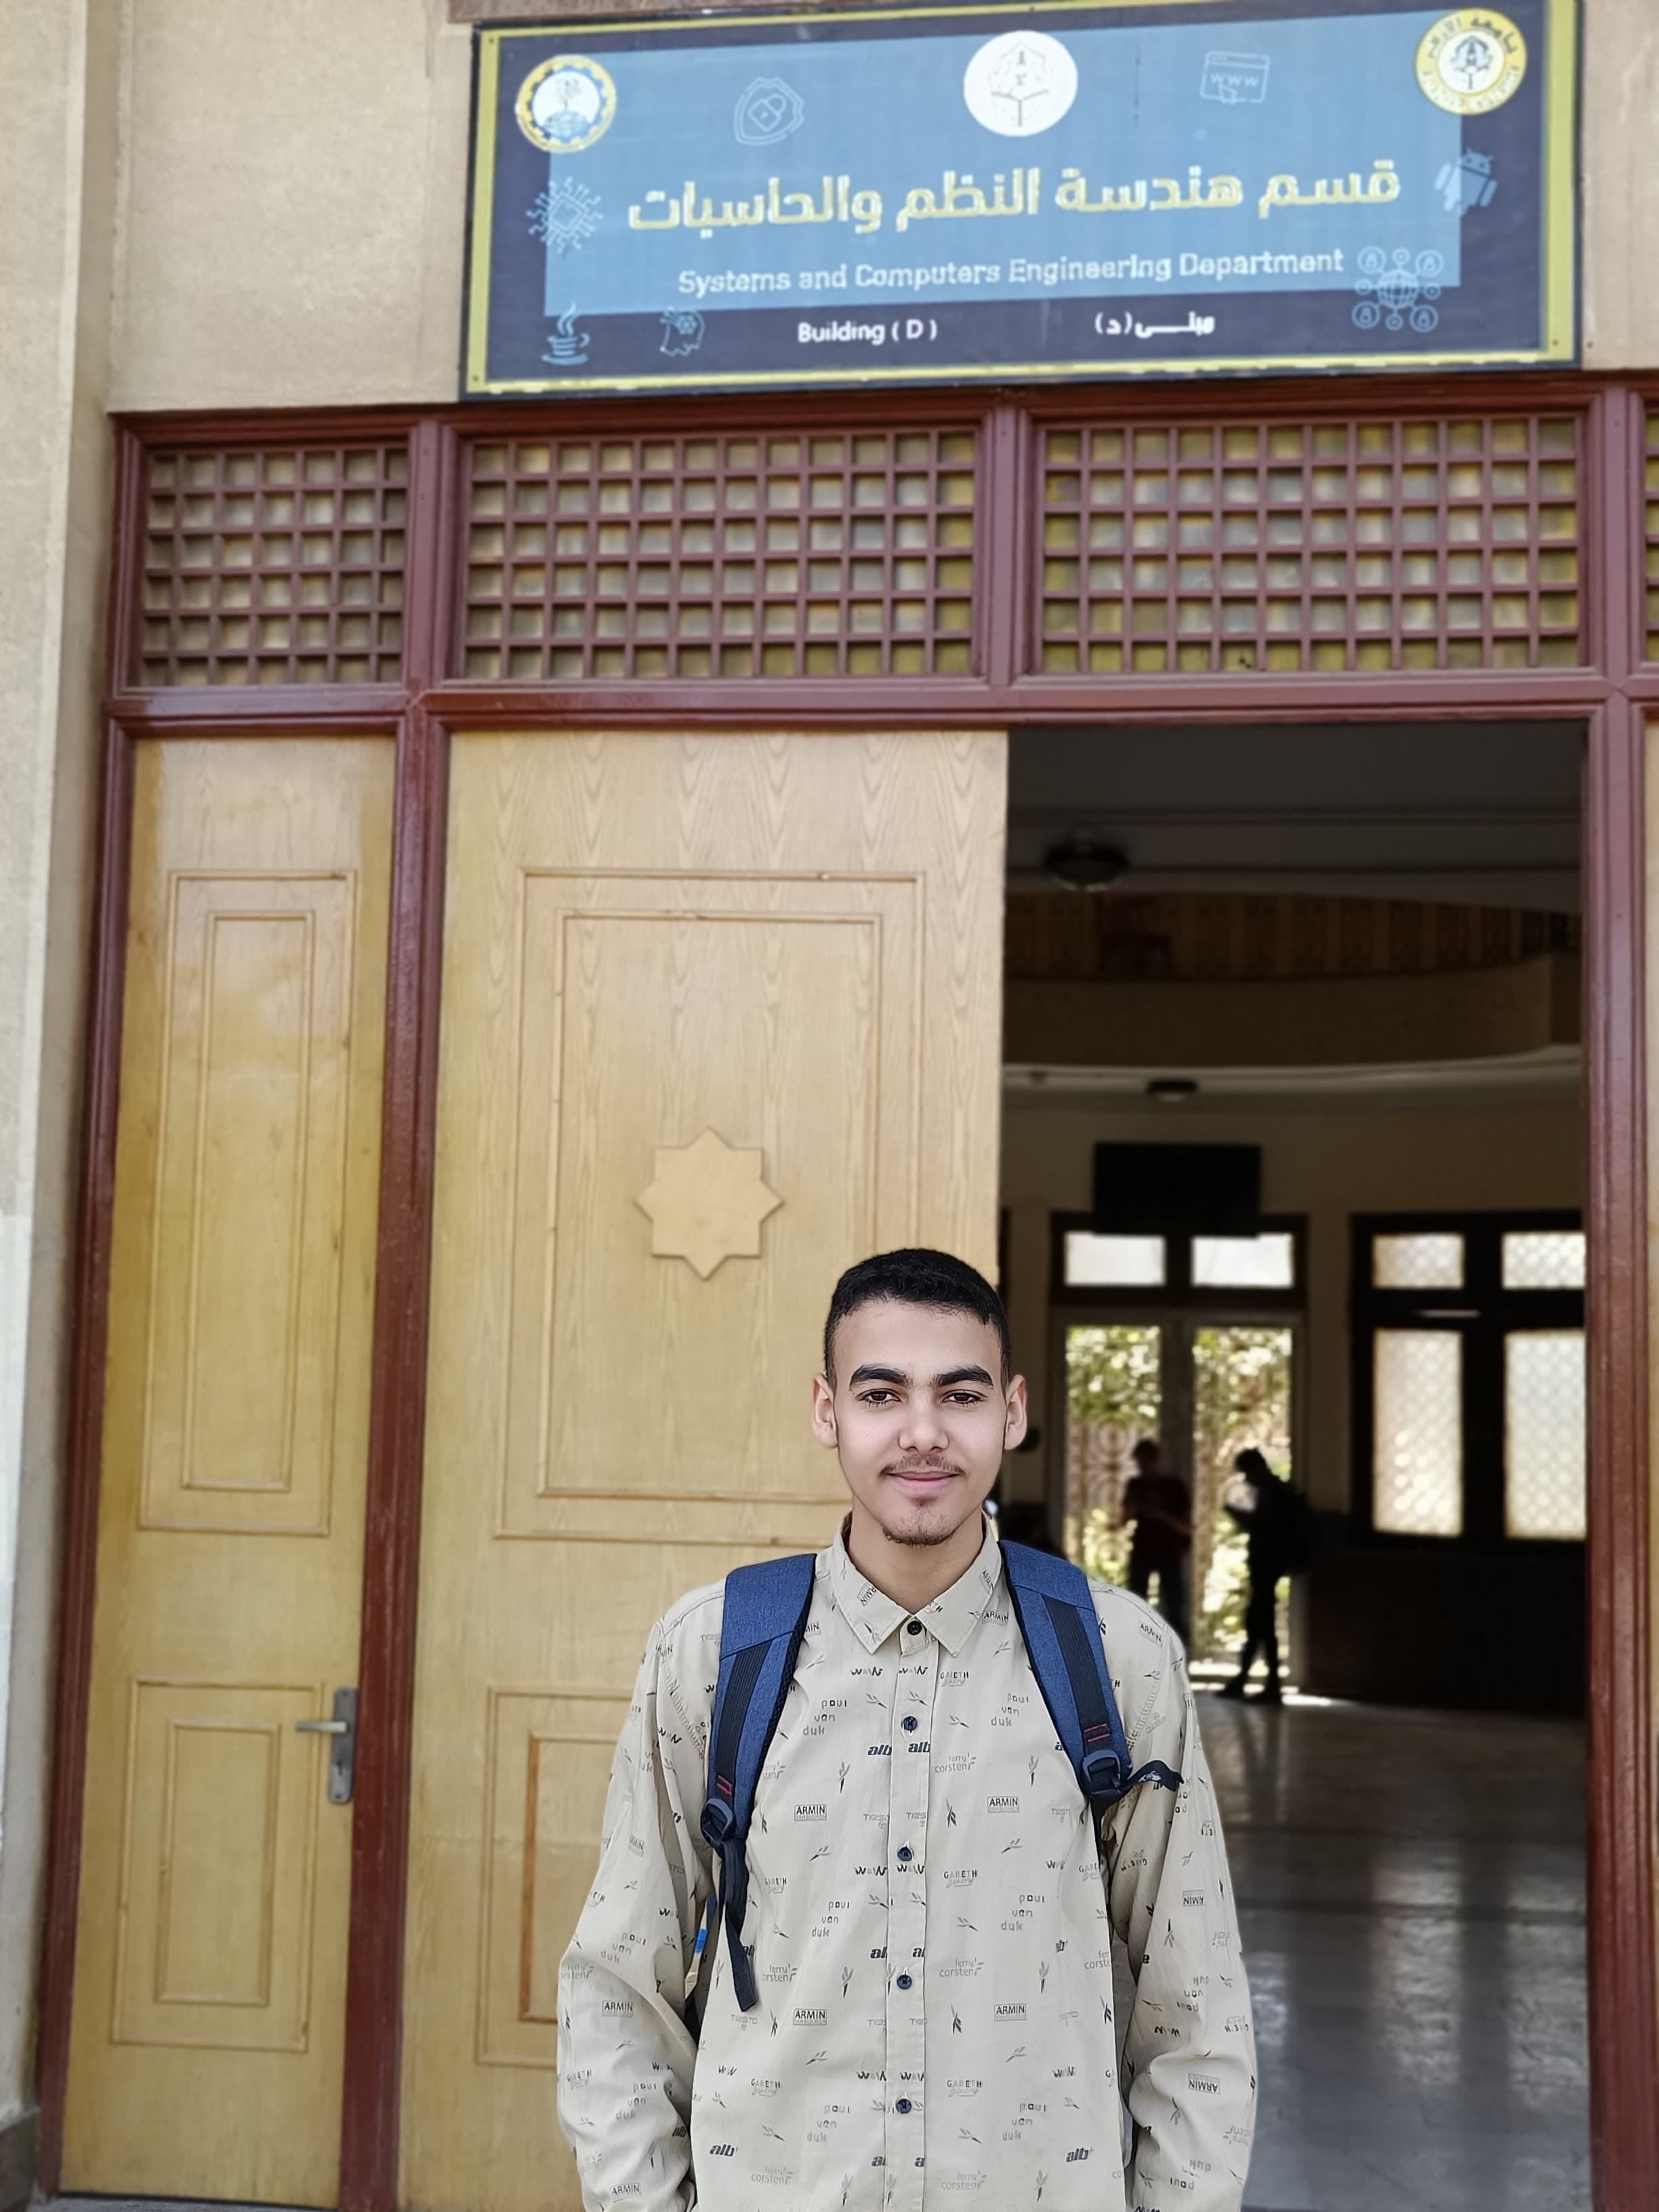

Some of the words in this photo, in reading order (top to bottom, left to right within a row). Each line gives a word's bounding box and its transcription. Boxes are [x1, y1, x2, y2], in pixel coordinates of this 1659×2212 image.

[1055, 165, 1244, 212] هندسة
[1258, 160, 1400, 220] قسم
[896, 167, 1041, 232] النظم
[628, 175, 883, 239] والحاسبات
[678, 270, 792, 298] Systems
[799, 264, 848, 290] and
[855, 262, 1001, 291] Computers
[1008, 254, 1172, 286] Engineering
[1179, 248, 1345, 281] Department
[797, 320, 886, 346] Building
[989, 1797, 1019, 1807] ARMIN
[796, 1805, 825, 1815] ARMIN
[944, 1870, 977, 1879] GARETH
[940, 1967, 974, 1978] corsten
[604, 2002, 633, 2011] ARMIN
[996, 2005, 1025, 2015] ARMIN
[795, 2010, 825, 2019] ARMIN
[751, 2078, 781, 2089] GARETH
[947, 2080, 982, 2088] GARETH
[1189, 2080, 1218, 2092] ARMIN
[611, 2184, 640, 2196] ARMIN
